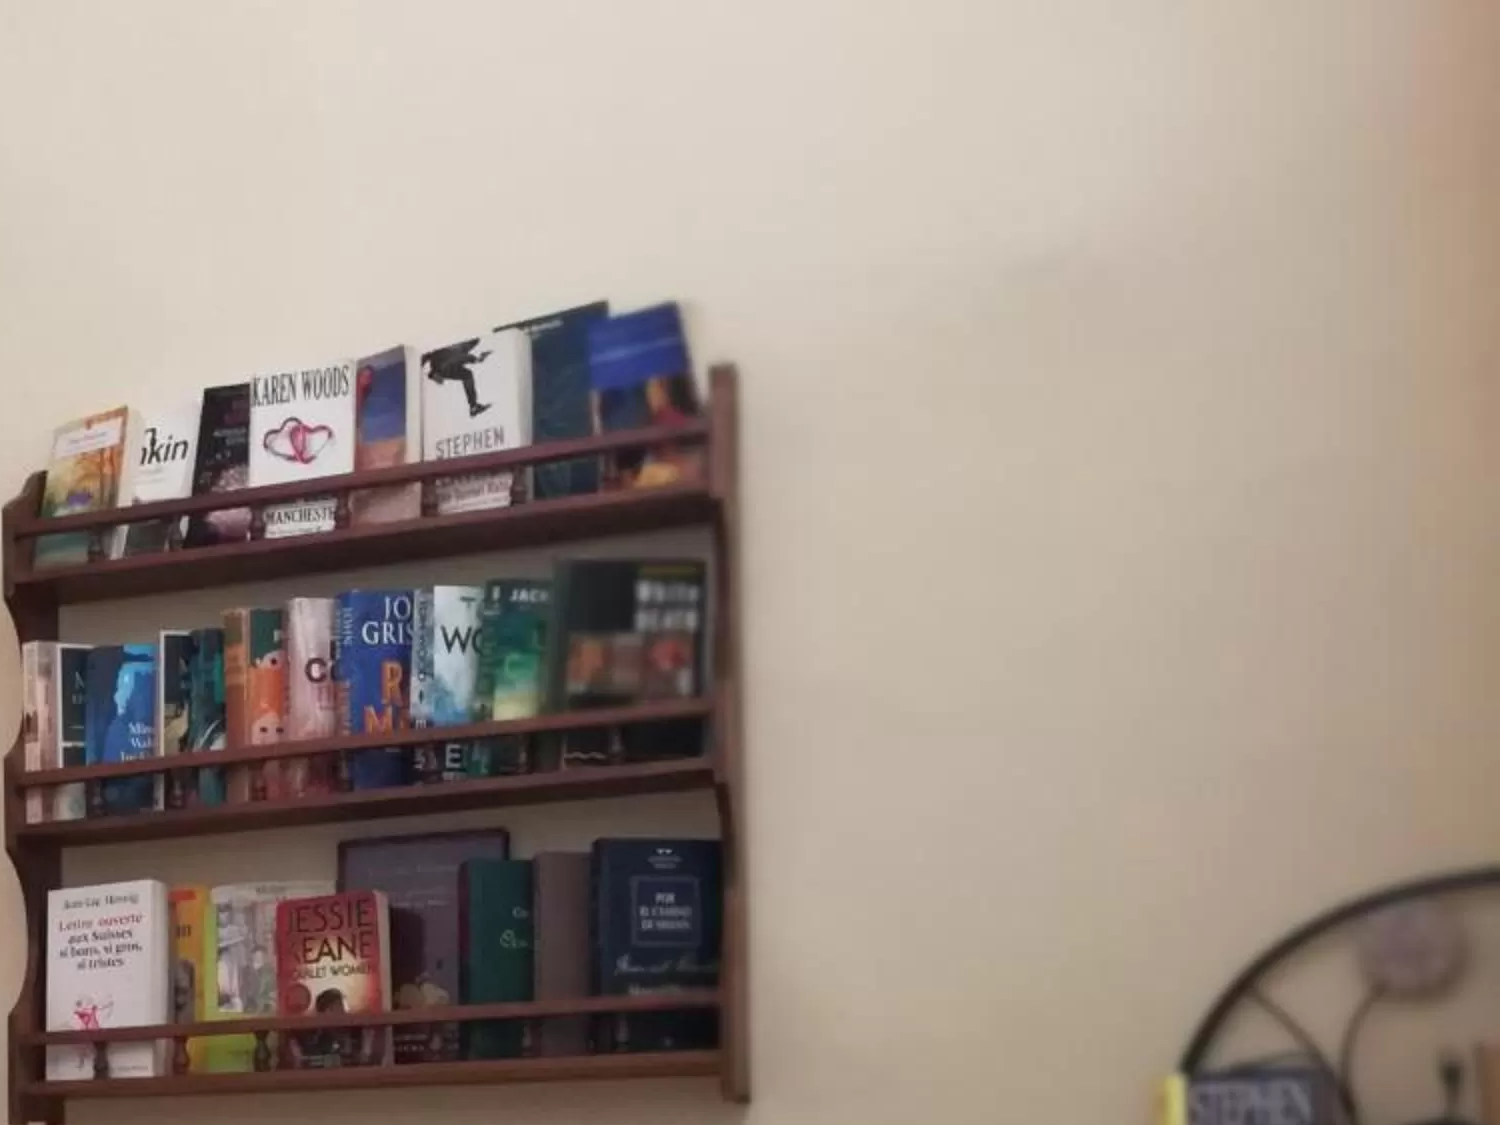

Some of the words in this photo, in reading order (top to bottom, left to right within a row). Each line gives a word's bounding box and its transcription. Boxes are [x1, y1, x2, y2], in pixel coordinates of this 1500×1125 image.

[251, 373, 297, 406] KAREN
[300, 363, 350, 401] WOODS
[435, 425, 505, 460] STEPHEN
